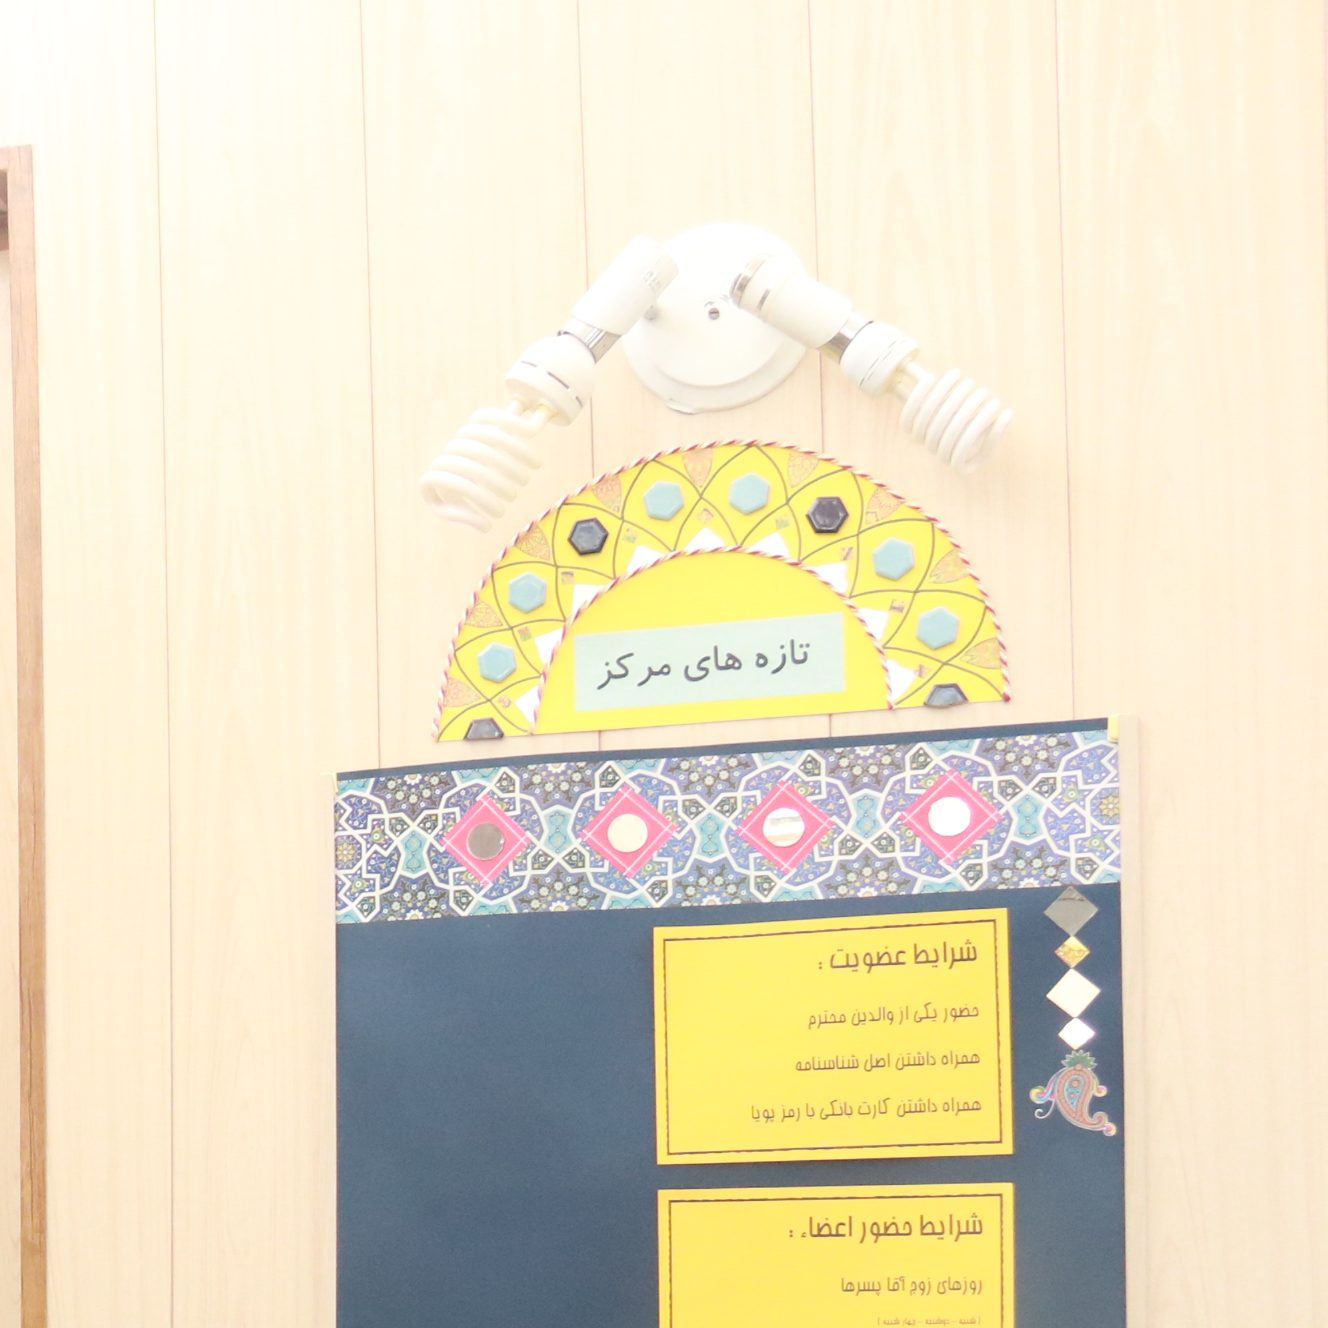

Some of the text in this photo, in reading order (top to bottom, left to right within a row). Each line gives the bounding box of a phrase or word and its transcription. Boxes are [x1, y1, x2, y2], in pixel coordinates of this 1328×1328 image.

[597, 639, 811, 690] تازه های مرکز
[830, 939, 978, 974] شرایط عضویت
[808, 1002, 979, 1030] حضور یکی از والدین محترم
[795, 1050, 980, 1072] همراه داشتن اصل شناسنامه
[751, 1096, 982, 1123] همراه داشتن کارت بانکی با رمز پویا
[800, 1212, 983, 1244] شرایط حضور اعضاء
[841, 1277, 882, 1297] پسرها
[909, 1277, 931, 1297] زوج
